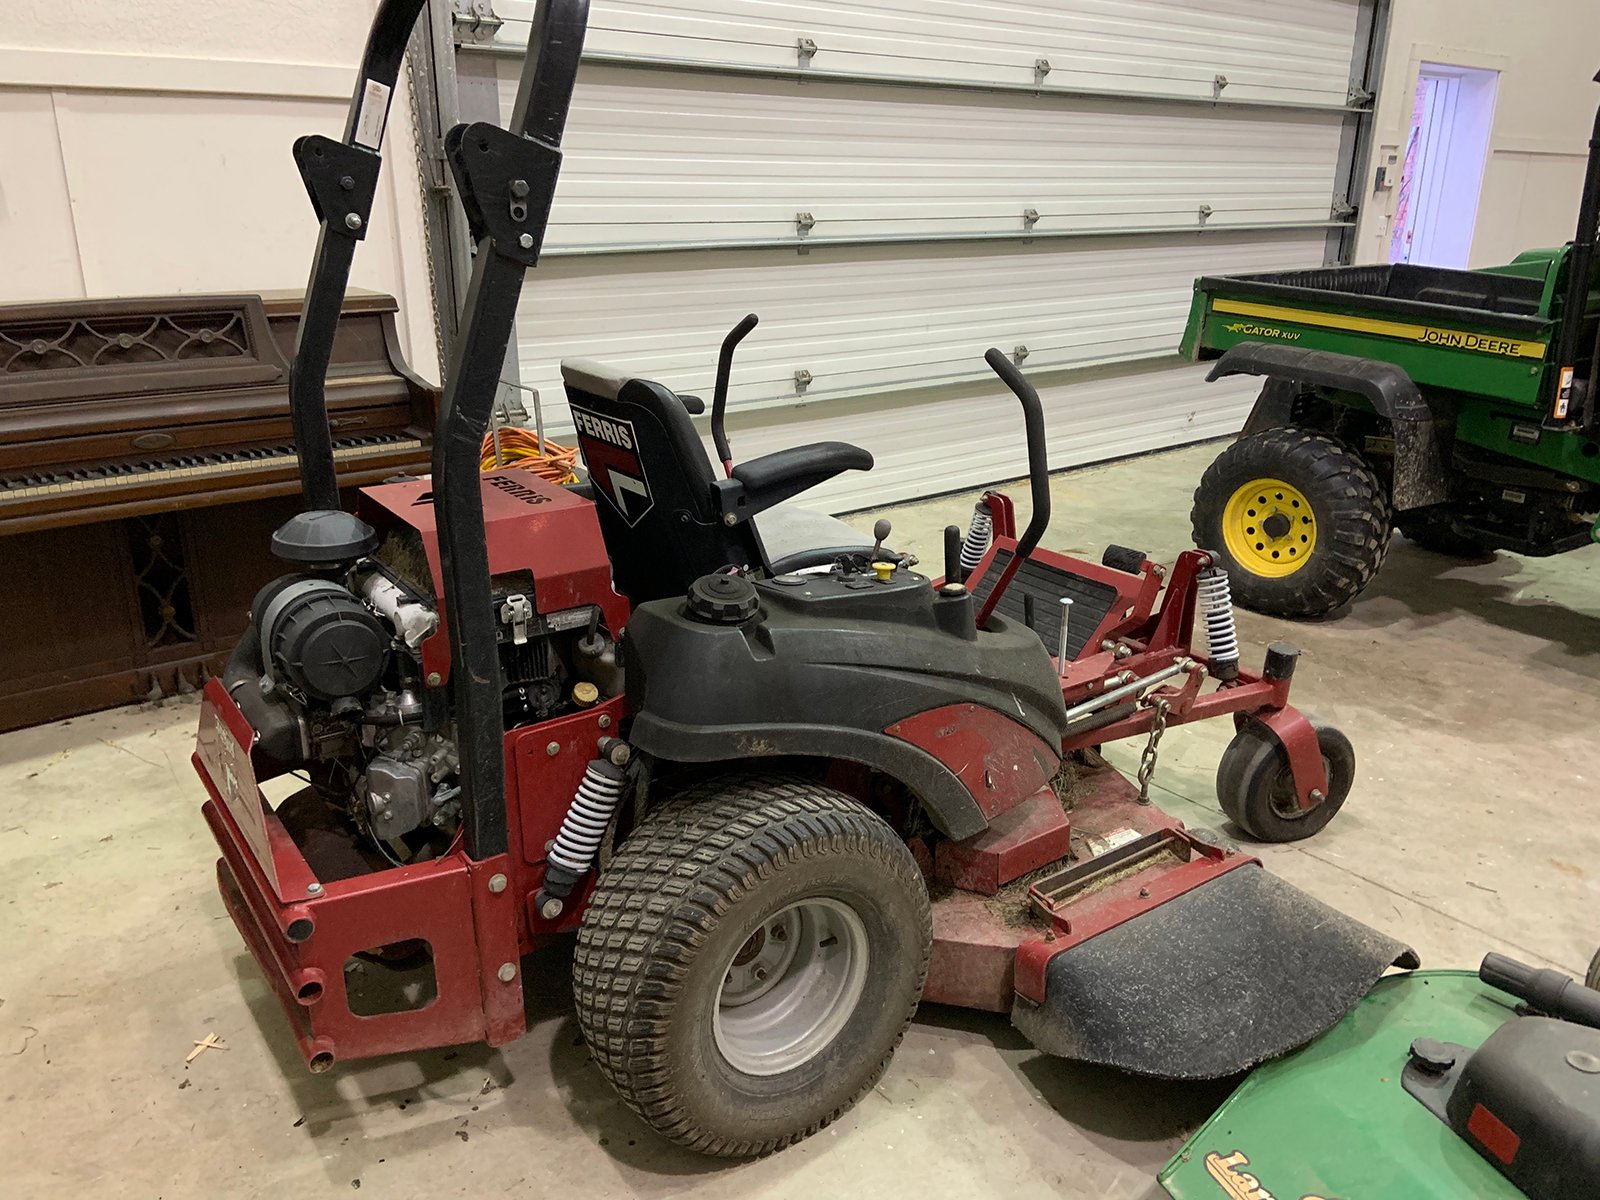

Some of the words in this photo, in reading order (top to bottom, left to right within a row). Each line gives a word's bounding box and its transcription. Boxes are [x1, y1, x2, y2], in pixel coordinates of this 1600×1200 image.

[1243, 324, 1280, 337] GATOR
[1281, 331, 1300, 340] XUV
[1418, 328, 1462, 345] JOHN
[1465, 334, 1521, 354] DEERE
[572, 409, 633, 450] FERRIS
[482, 475, 552, 505] FERRIS
